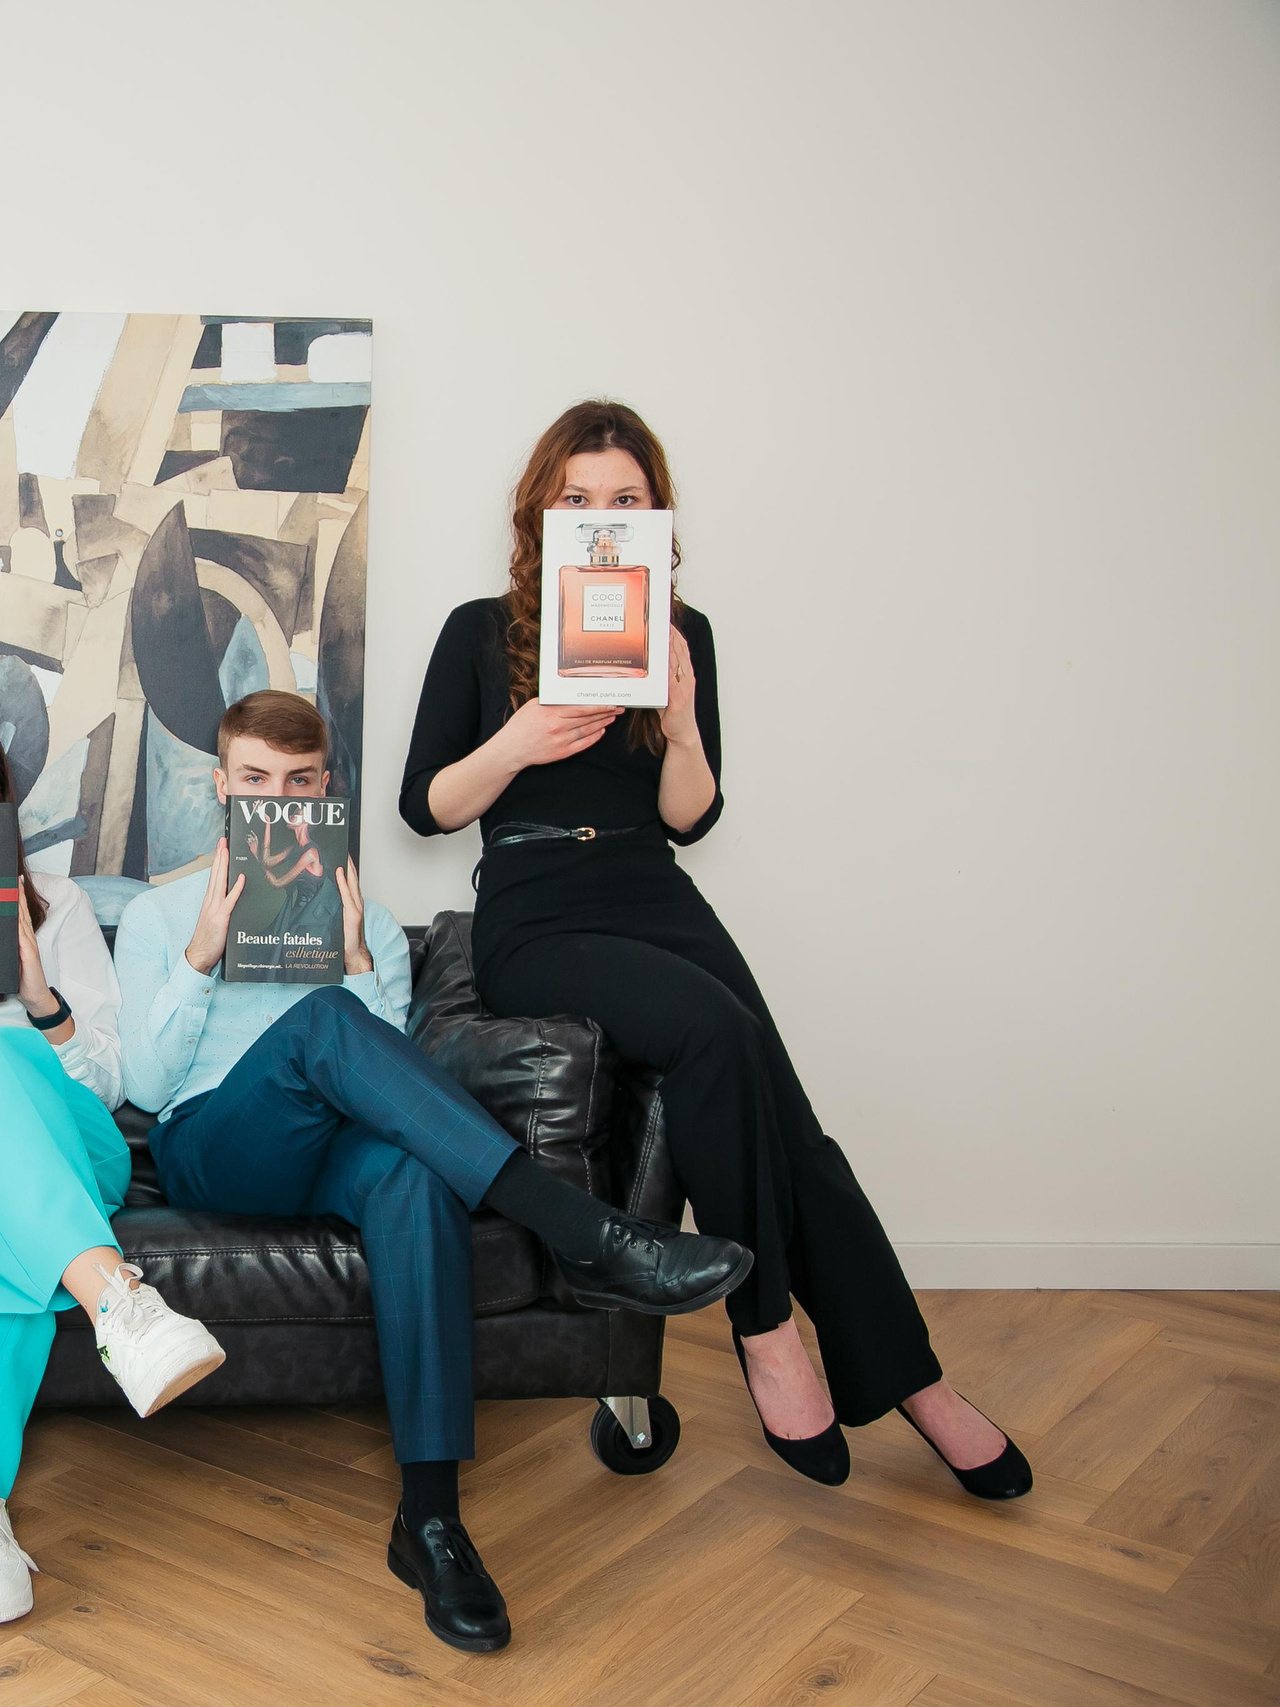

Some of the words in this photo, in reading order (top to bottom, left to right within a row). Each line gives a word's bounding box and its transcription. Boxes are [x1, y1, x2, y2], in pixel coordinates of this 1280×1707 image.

[591, 593, 623, 601] COCO
[237, 799, 345, 826] VOGUE
[236, 931, 280, 945] Beaute
[283, 931, 323, 946] fatales
